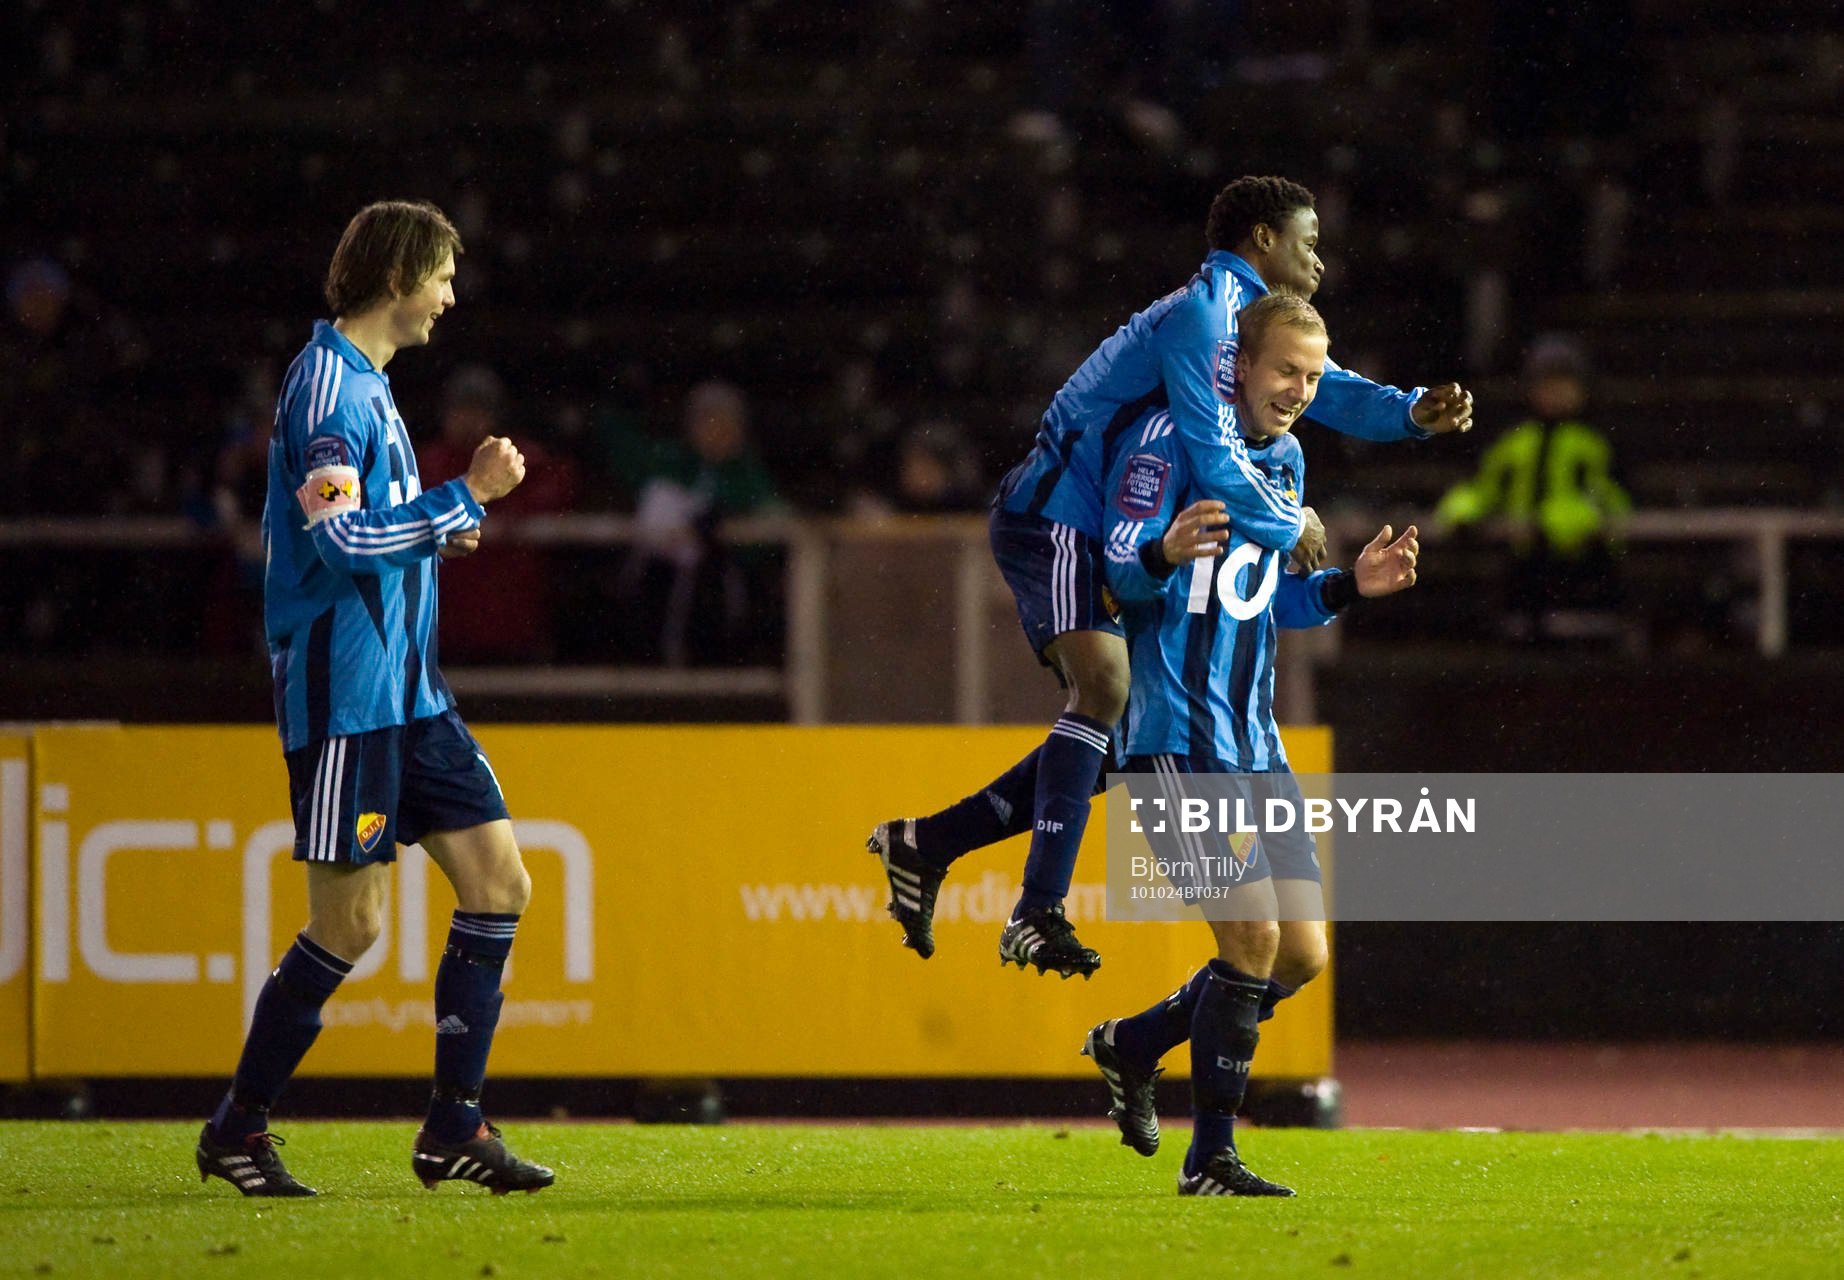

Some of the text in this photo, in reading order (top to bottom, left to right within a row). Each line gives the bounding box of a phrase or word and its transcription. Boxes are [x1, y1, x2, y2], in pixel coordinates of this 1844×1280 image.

[1187, 541, 1279, 621] 10
[1036, 819, 1064, 834] DIF
[1216, 1055, 1253, 1075] DIF
